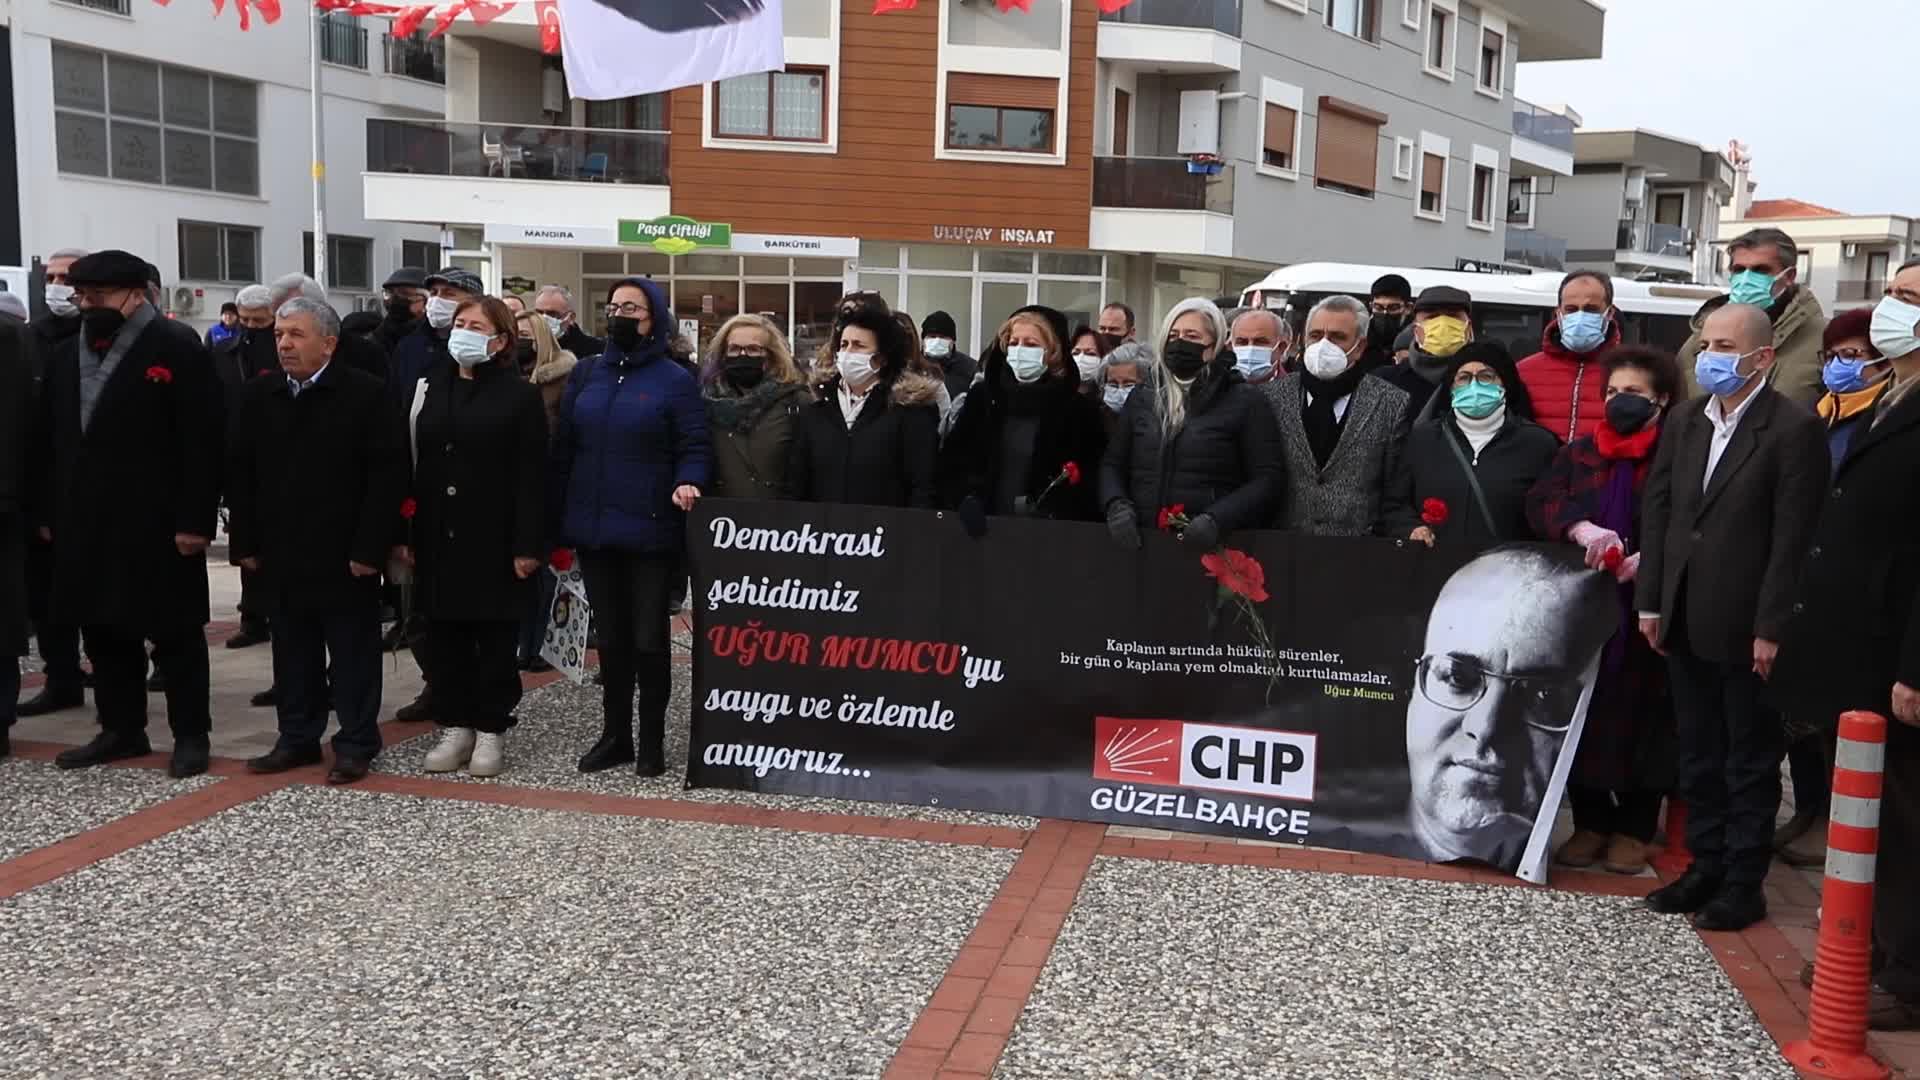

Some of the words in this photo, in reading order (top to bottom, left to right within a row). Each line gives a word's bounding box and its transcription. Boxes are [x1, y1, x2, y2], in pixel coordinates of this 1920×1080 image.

[524, 229, 575, 240] MANDIRA
[637, 223, 666, 236] Paşa
[669, 224, 712, 239] Çiftliği
[933, 225, 993, 244] ULUÇAY
[709, 516, 885, 558] Demokrasi
[707, 575, 860, 612] şehidimiz
[707, 620, 810, 666] UĞUR
[1106, 638, 1166, 655] Kaplanın
[1169, 644, 1223, 656] sırtında
[1279, 649, 1344, 665] sürenler,
[1060, 652, 1080, 665] bir
[1084, 655, 1111, 669] gün
[1113, 659, 1123, 669] o
[1126, 657, 1180, 674] kaplana
[1185, 663, 1215, 675] yem
[1288, 665, 1392, 686] kurtulamazlar.
[704, 688, 793, 724] saygı
[798, 697, 832, 719] ve
[837, 694, 956, 731] özlemle
[1324, 684, 1351, 698] Uğur
[1353, 687, 1394, 701] Mumcu
[703, 743, 871, 778] anıyoruz...
[1191, 735, 1304, 785] CHP
[1091, 785, 1311, 836] GÜZELBAHÇE
